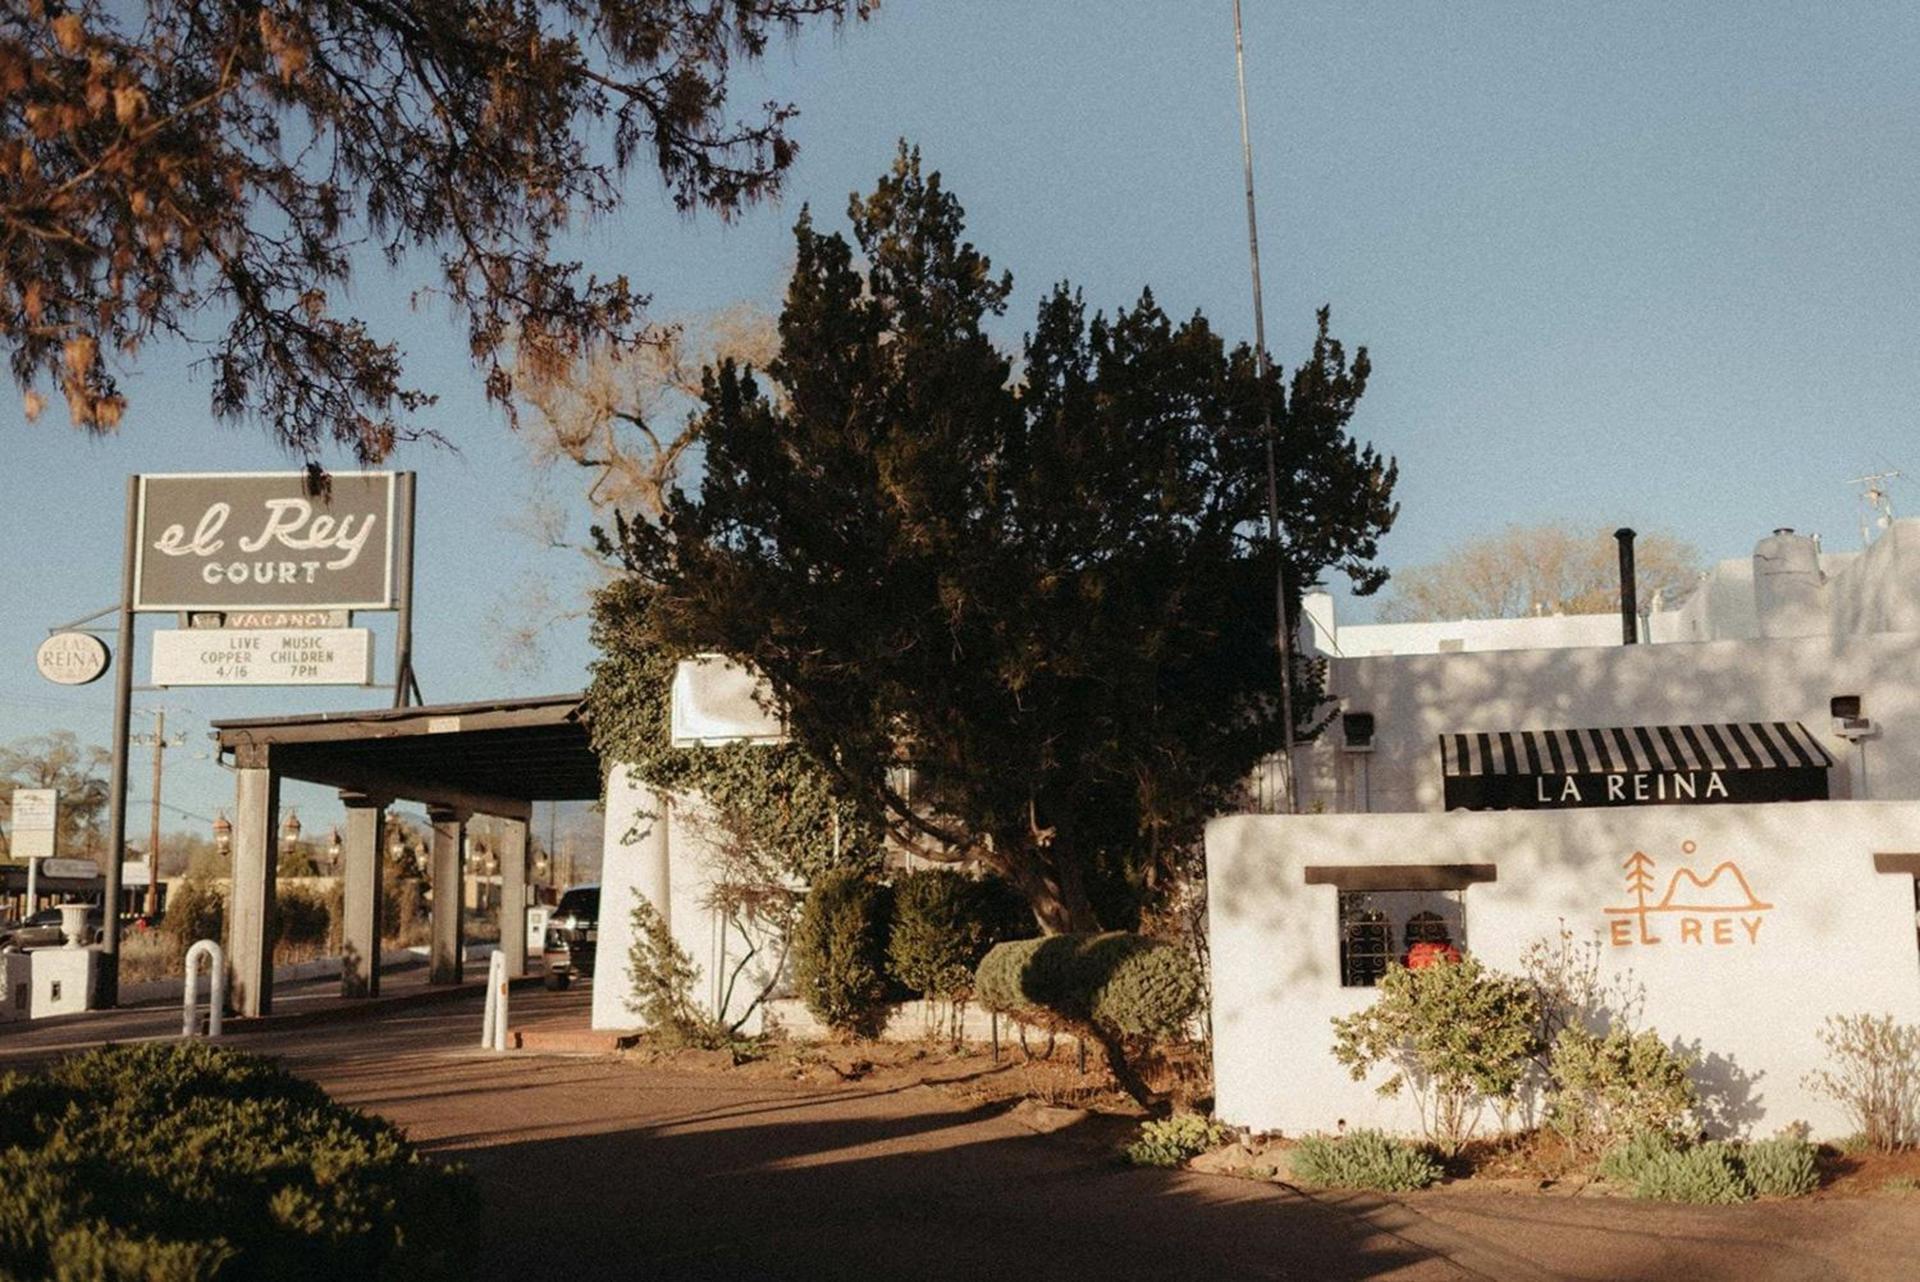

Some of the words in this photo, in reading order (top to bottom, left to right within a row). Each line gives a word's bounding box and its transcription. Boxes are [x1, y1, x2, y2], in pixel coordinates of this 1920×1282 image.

[153, 502, 230, 556] el
[238, 498, 376, 570] Rey
[203, 561, 320, 584] COURT
[230, 614, 330, 627] VACANCY
[230, 637, 260, 650] LIVE
[282, 637, 322, 649] MUSIC
[43, 651, 98, 667] REINA
[200, 651, 252, 663] COPPER
[270, 651, 333, 663] CHILDREN
[216, 666, 248, 678] 4/16
[290, 665, 318, 677] 7PM
[1537, 776, 1582, 801] LA
[1607, 772, 1729, 800] REINA
[1610, 919, 1661, 946] EL
[1681, 916, 1763, 944] REY
